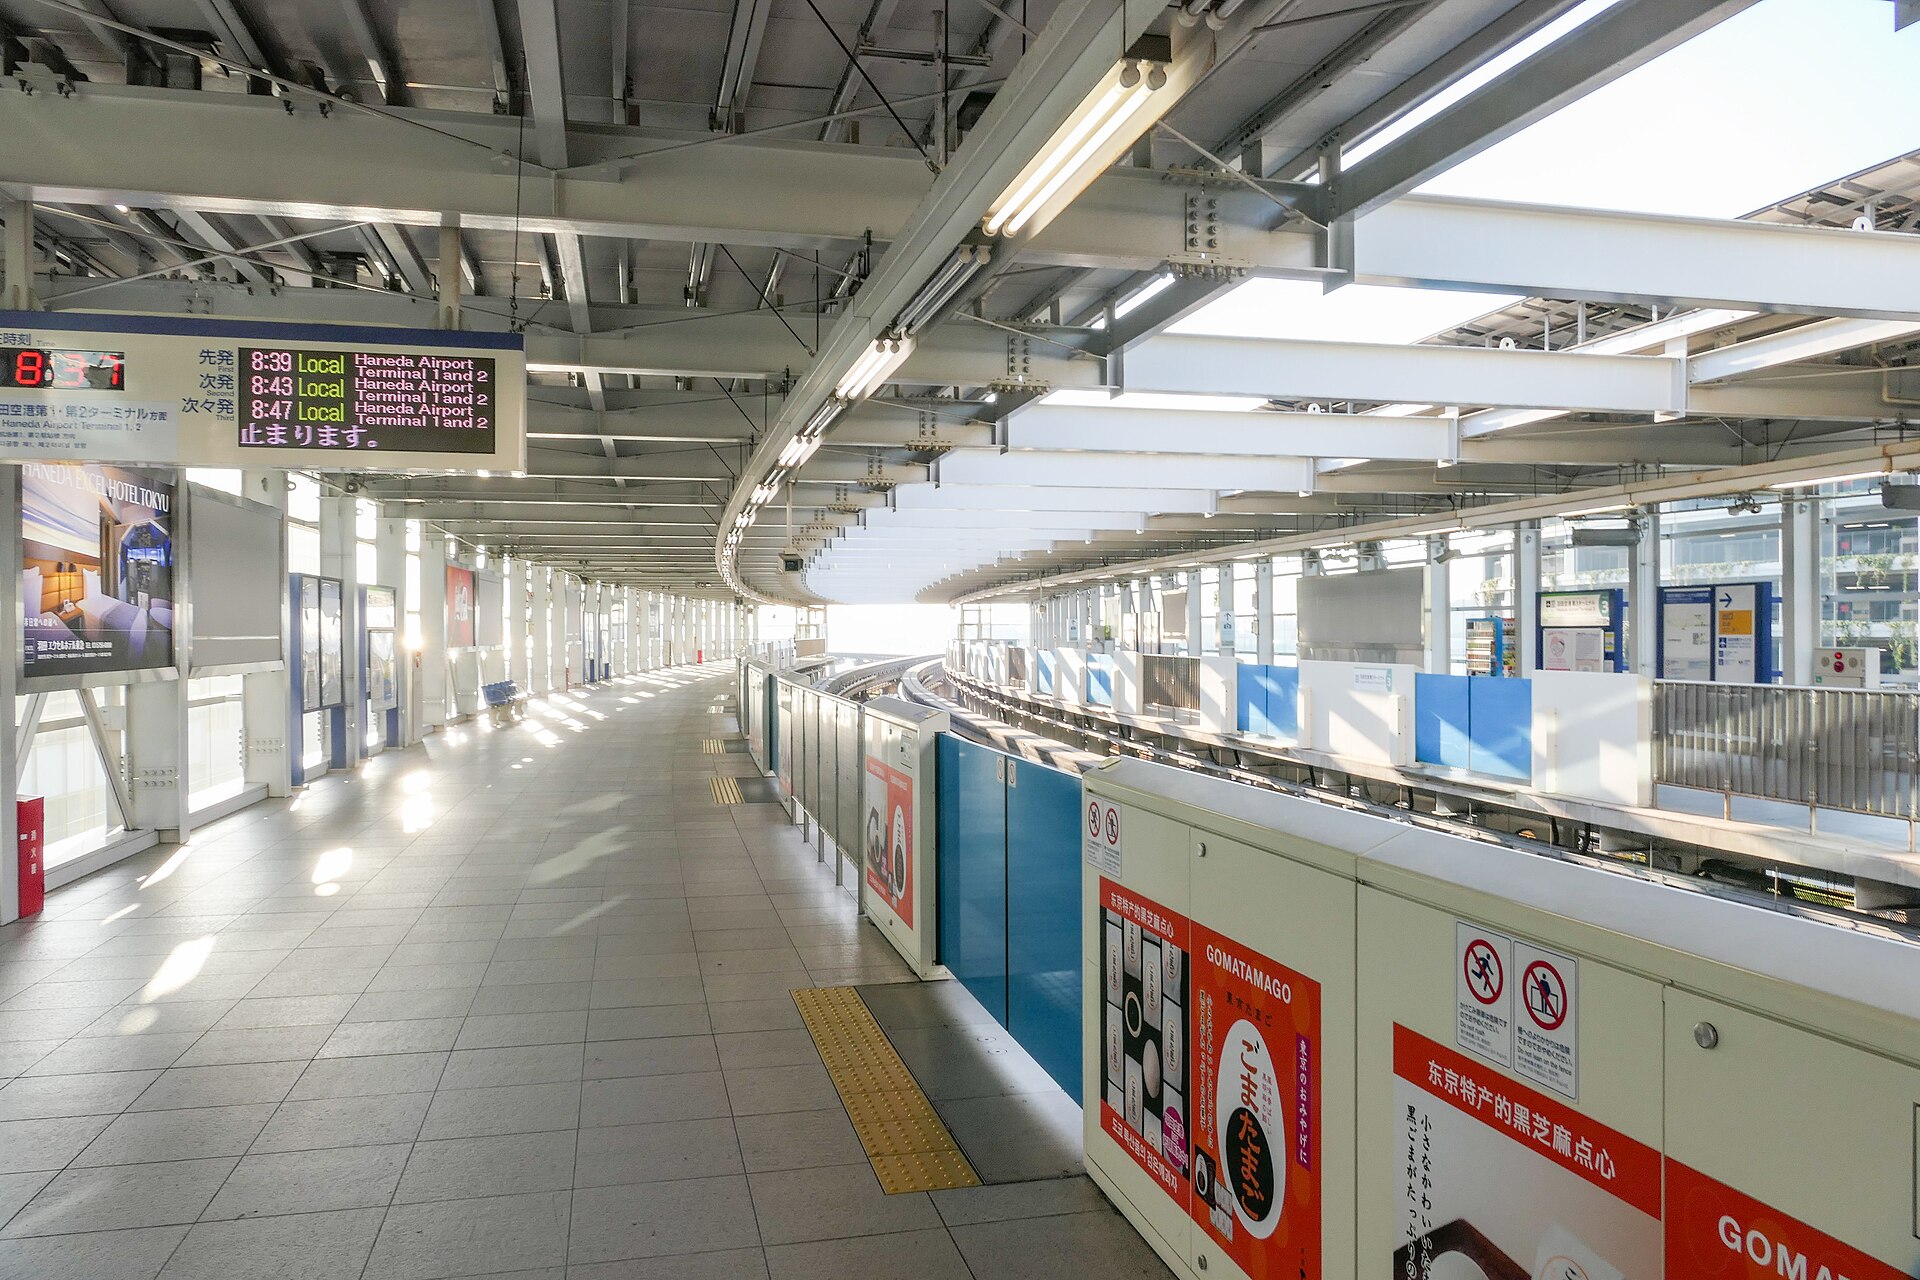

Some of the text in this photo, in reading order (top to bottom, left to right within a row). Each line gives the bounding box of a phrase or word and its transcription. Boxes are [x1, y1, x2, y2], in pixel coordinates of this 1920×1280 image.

[0, 333, 31, 346] 時刻
[200, 349, 233, 366] 先発
[252, 352, 344, 374] 8:39 Local
[355, 354, 473, 370] Haneda Airport
[199, 374, 233, 390] 次発
[355, 366, 426, 380] Terminal
[443, 370, 473, 381] and
[477, 371, 488, 382] 2
[252, 376, 344, 398] 8:43 Local
[355, 377, 473, 393] Haneda Airport
[181, 397, 233, 414] 次々発
[355, 389, 426, 403] Terminal
[443, 393, 473, 404] and
[477, 394, 488, 405] 2
[252, 400, 344, 422] 8:47 Local
[355, 401, 473, 417] Haneda Airport
[2, 419, 40, 428] Haneda
[42, 421, 78, 431] Airport
[355, 413, 426, 427] Terminal
[443, 417, 473, 428] and
[477, 418, 488, 429] 2
[240, 422, 378, 448] 止まります。
[75, 471, 107, 497] EXCEL
[108, 479, 139, 505] HOTEL
[139, 488, 169, 512] TOKYU
[1206, 944, 1291, 1005] GOMATAMAGO
[1299, 1039, 1308, 1164] 東京のおみやげに
[1427, 1059, 1616, 1181] 东京特产的黑芝麻点心
[1239, 1040, 1265, 1221] ごまたまご
